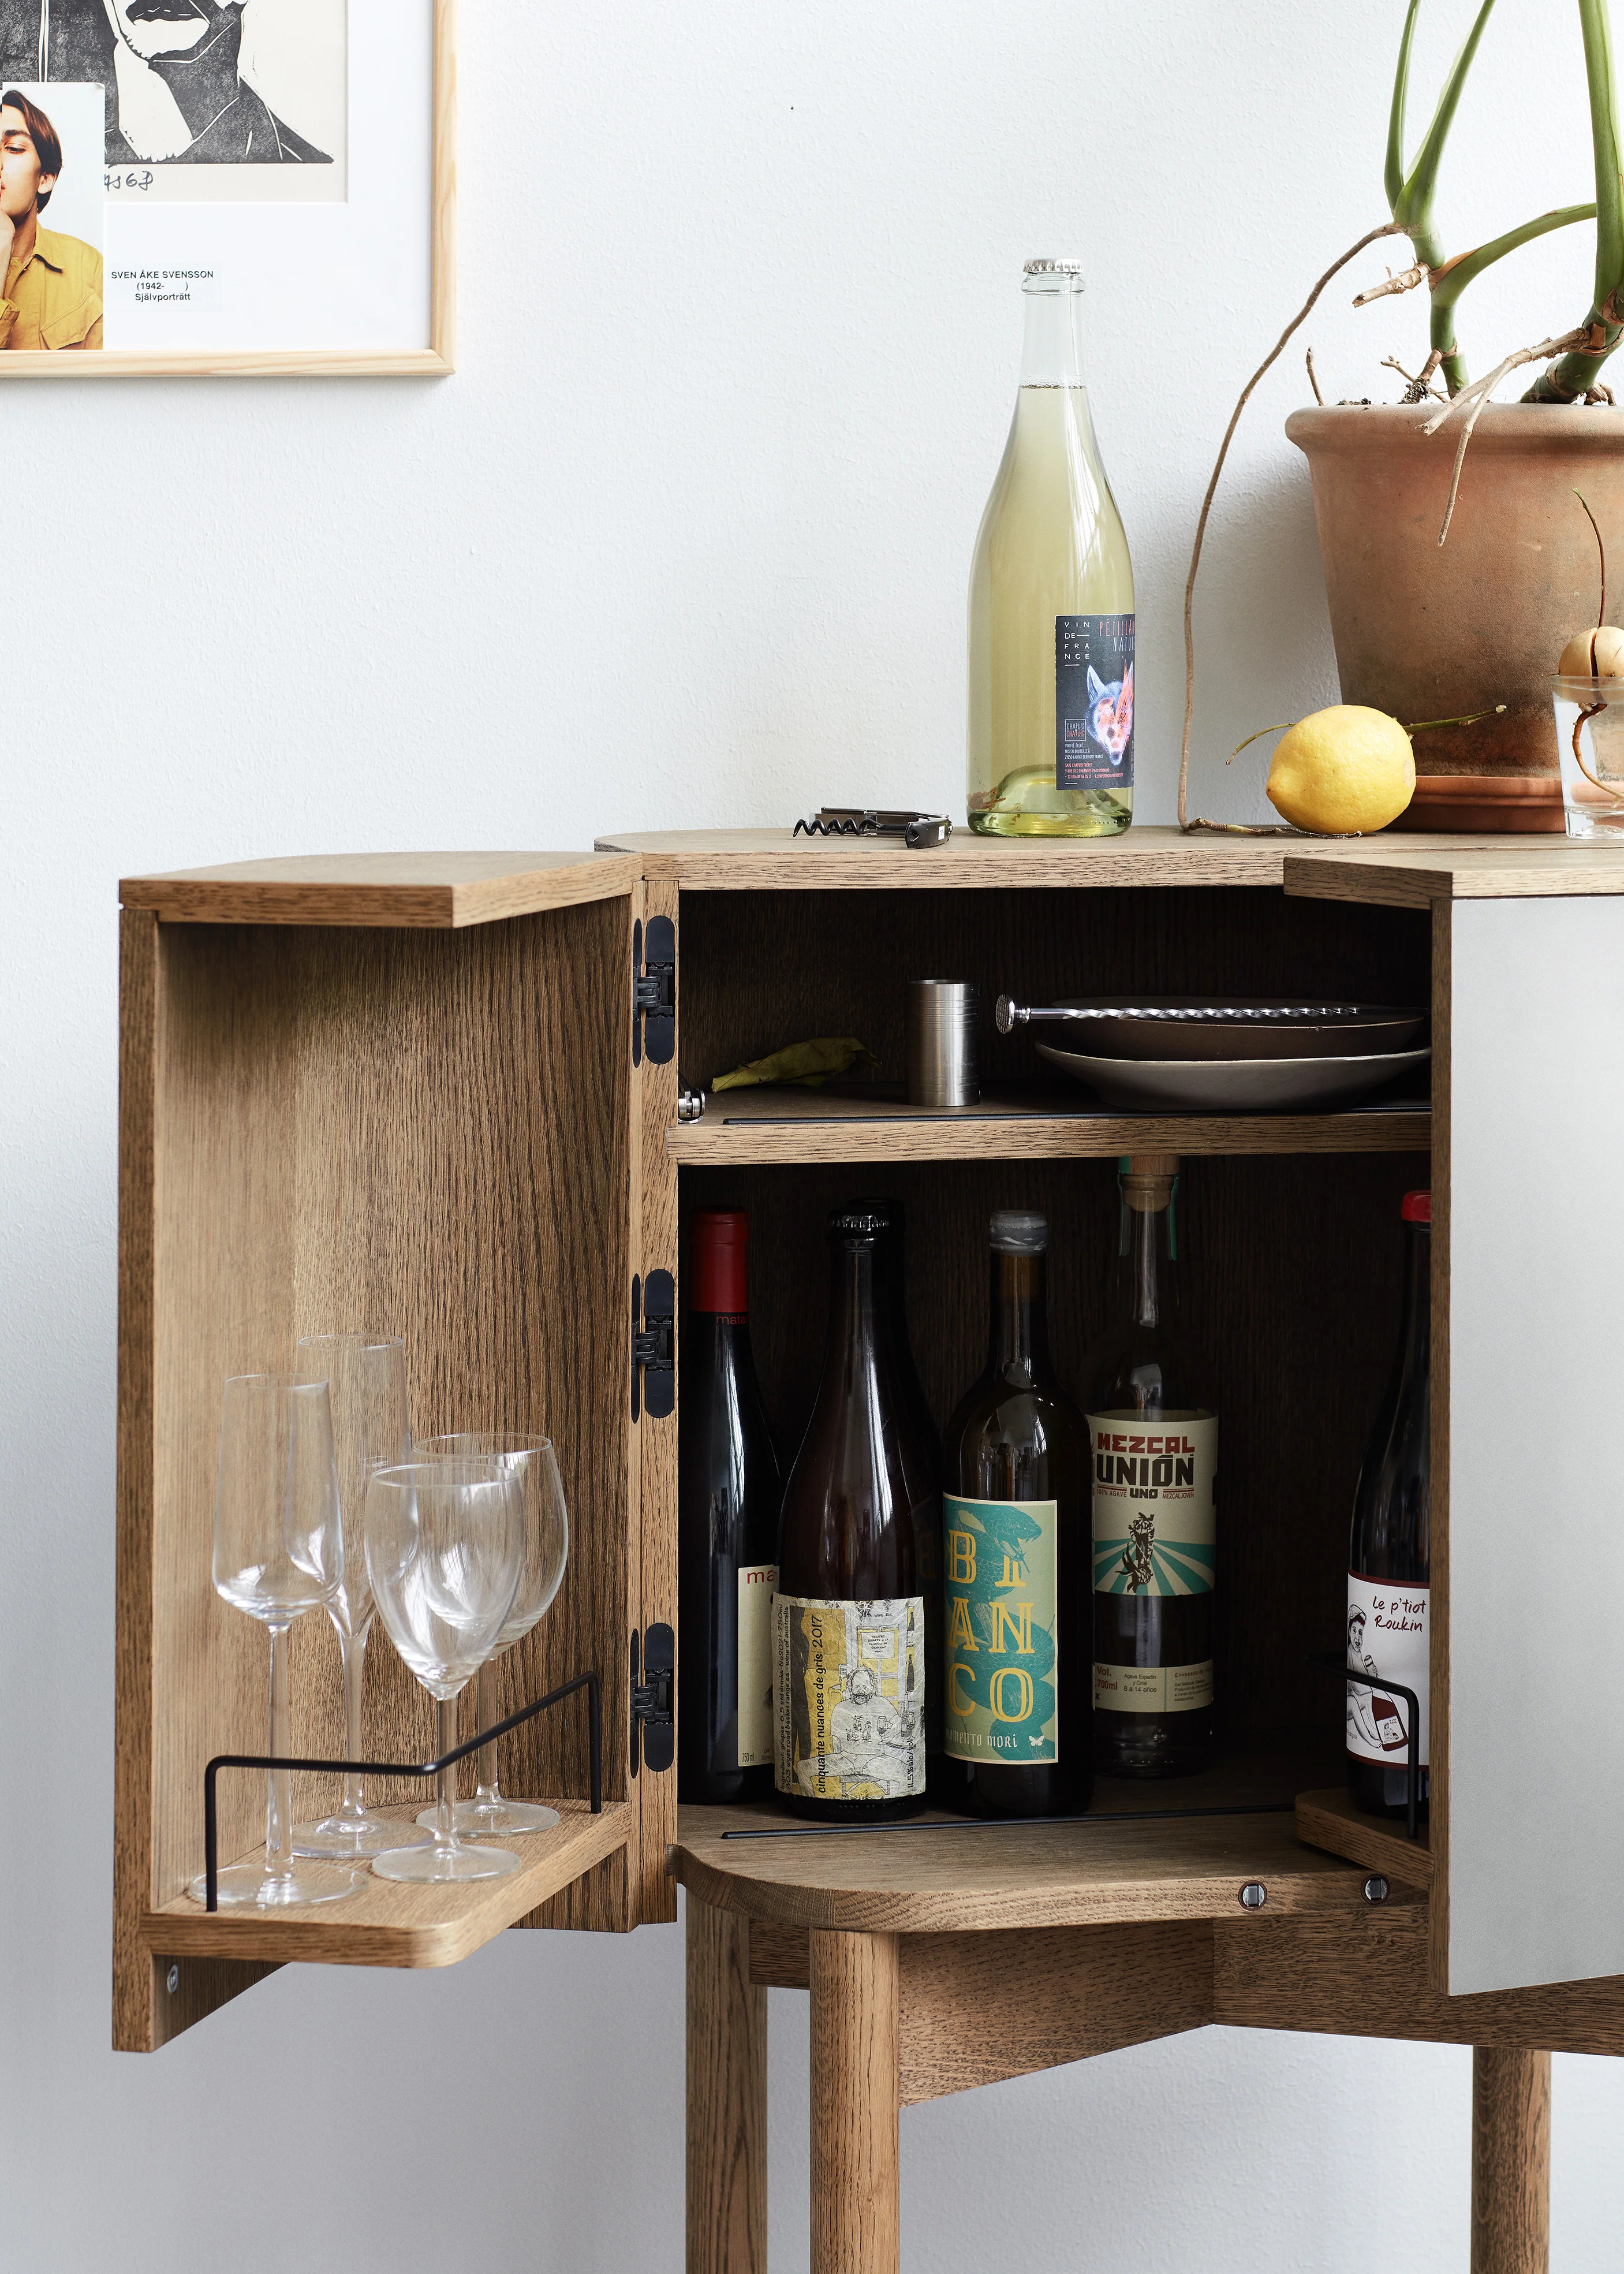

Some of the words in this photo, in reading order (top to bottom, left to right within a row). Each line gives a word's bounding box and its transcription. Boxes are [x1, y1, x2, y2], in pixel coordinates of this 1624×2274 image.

[139, 269, 159, 278] ÅKE
[136, 282, 165, 291] (1942-
[135, 293, 191, 302] Självporträtt
[1097, 1432, 1195, 1454] MEZCAL
[1096, 1453, 1194, 1487] UNIÓN
[1129, 1488, 1158, 1499] UNO
[1374, 1615, 1423, 1632] Roukin
[811, 1615, 823, 1648] 2017
[783, 1639, 789, 1647] of
[813, 1654, 827, 1674] gris
[1097, 1666, 1111, 1676] Vol.
[813, 1677, 823, 1690] de
[816, 1693, 824, 1738] nuances
[816, 1740, 829, 1793] cinquante
